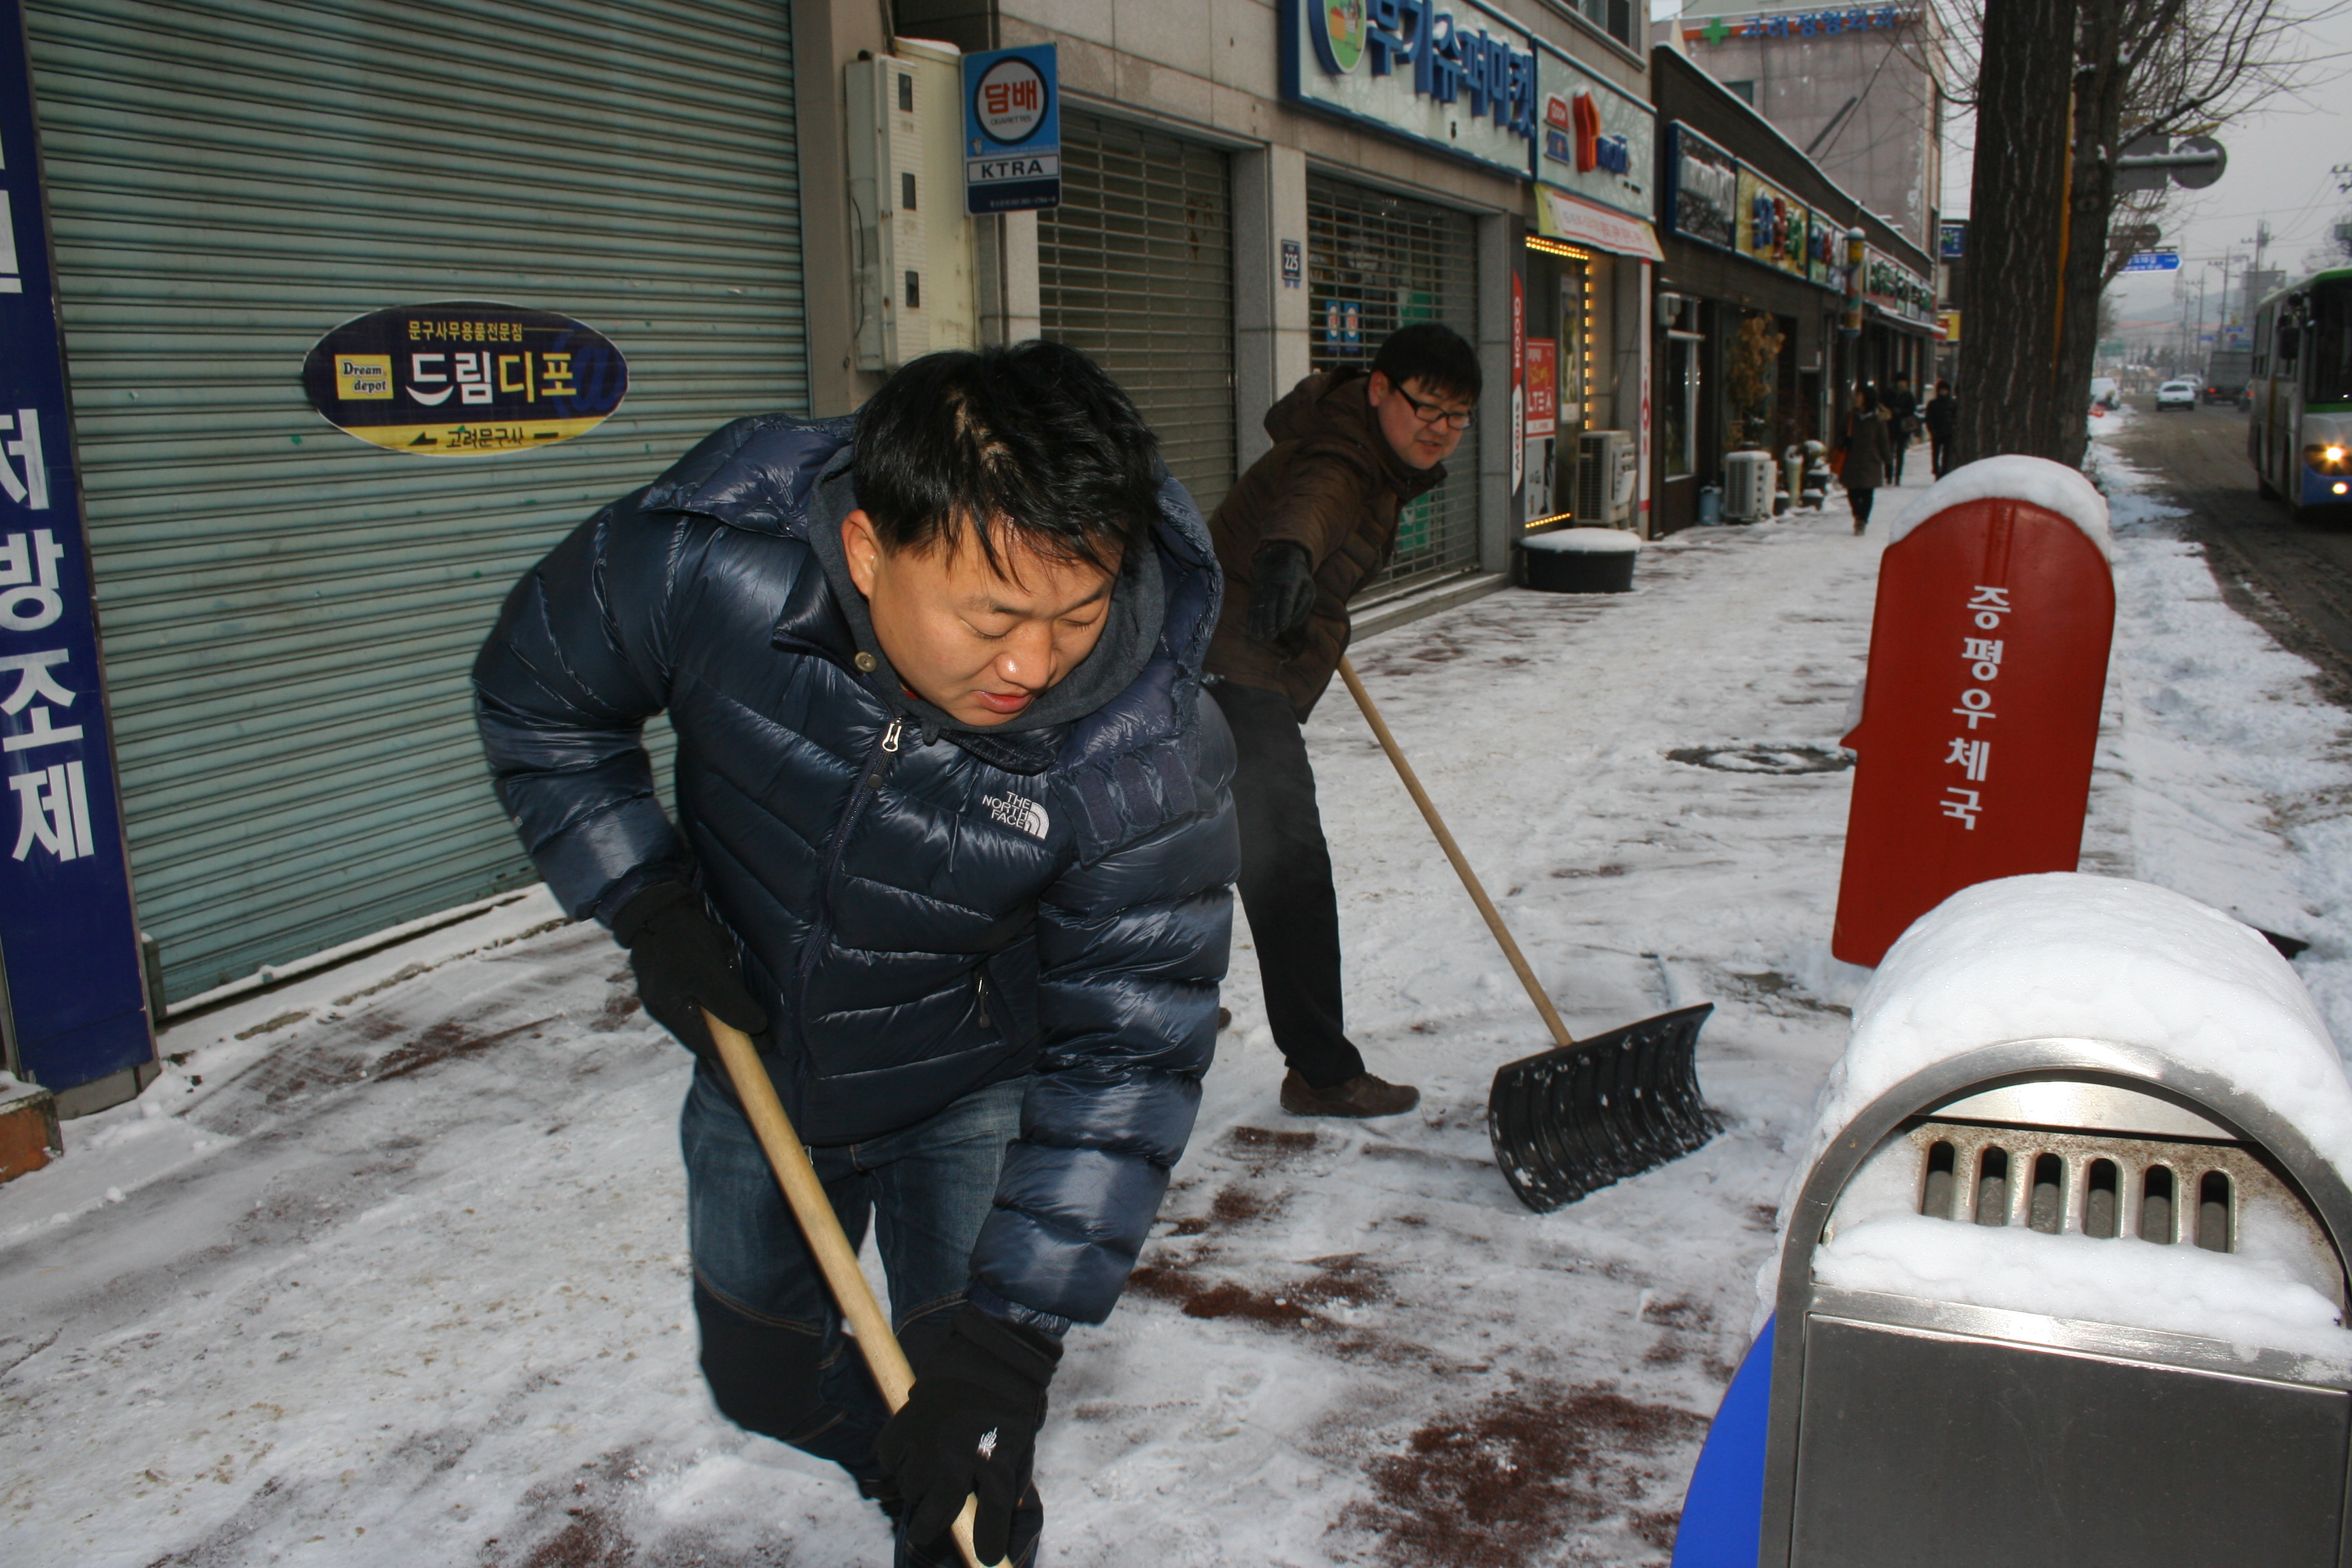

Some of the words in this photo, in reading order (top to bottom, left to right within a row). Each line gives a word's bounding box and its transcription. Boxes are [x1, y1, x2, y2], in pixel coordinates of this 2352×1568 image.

[985, 79, 1037, 114] 담배
[982, 159, 1043, 178] KTRA
[1284, 254, 1298, 270] 225
[408, 321, 522, 342] 문구사무용품전문점
[342, 361, 382, 376] Dream
[406, 350, 577, 406] 드림디포
[354, 379, 387, 393] depot
[446, 427, 525, 448] 고려문구사
[1940, 585, 2011, 830] 증평우체국
[982, 794, 1029, 821] NORTH
[1007, 791, 1032, 809] THE
[991, 808, 1024, 828] FACE
